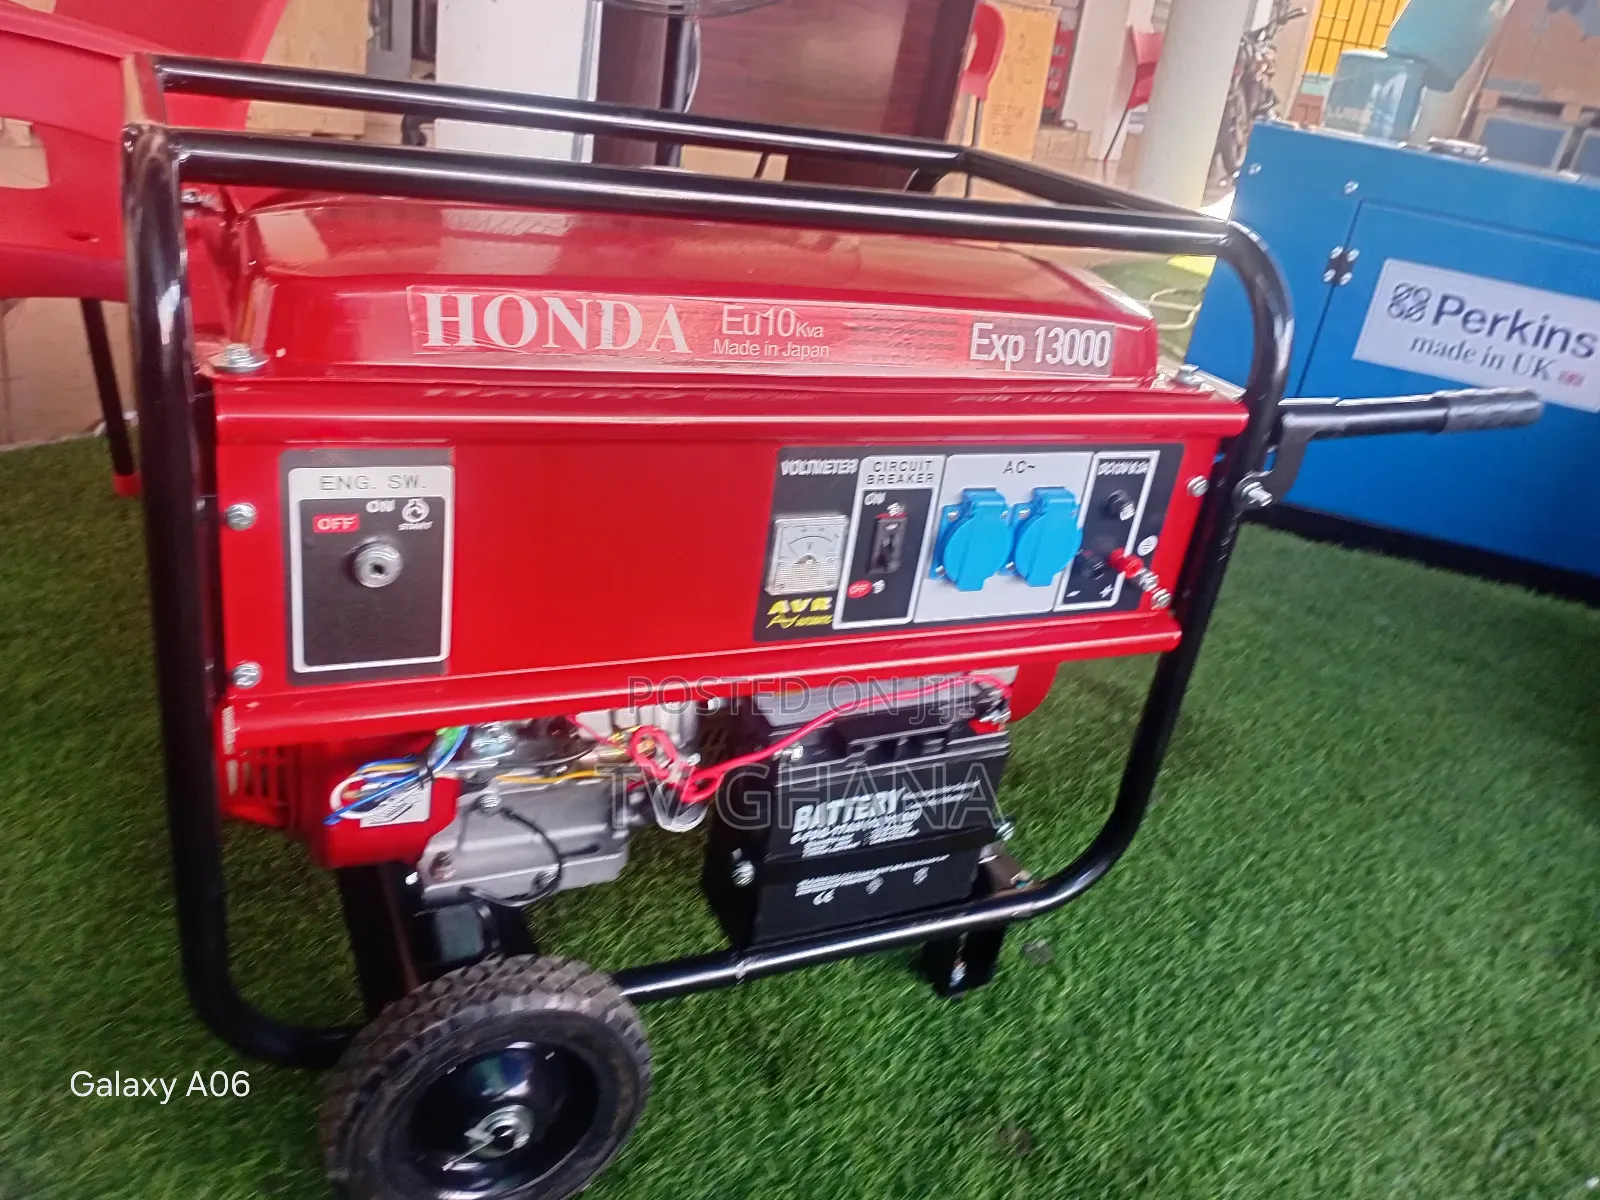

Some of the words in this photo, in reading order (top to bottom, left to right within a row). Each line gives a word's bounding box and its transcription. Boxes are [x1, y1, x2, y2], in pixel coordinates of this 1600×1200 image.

[420, 292, 692, 354] HONDA
[1431, 293, 1599, 358] Perkins
[713, 339, 760, 356] Made
[763, 340, 778, 357] in
[782, 342, 830, 359] Japan
[969, 322, 1025, 370] Exp
[1033, 326, 1111, 368] 13000
[1409, 335, 1477, 364] made
[1480, 345, 1505, 371] in
[1512, 353, 1559, 382] UK
[781, 458, 859, 476] VOLTMETER
[872, 460, 933, 473] CIRCUIT
[319, 475, 377, 491] ENG.
[387, 474, 427, 490] SW.
[866, 473, 935, 485] BREAKER
[365, 499, 396, 513] ON
[864, 491, 887, 506] ON
[316, 515, 357, 531] OFF
[767, 596, 833, 616] AVR
[792, 787, 906, 834] BATTERY
